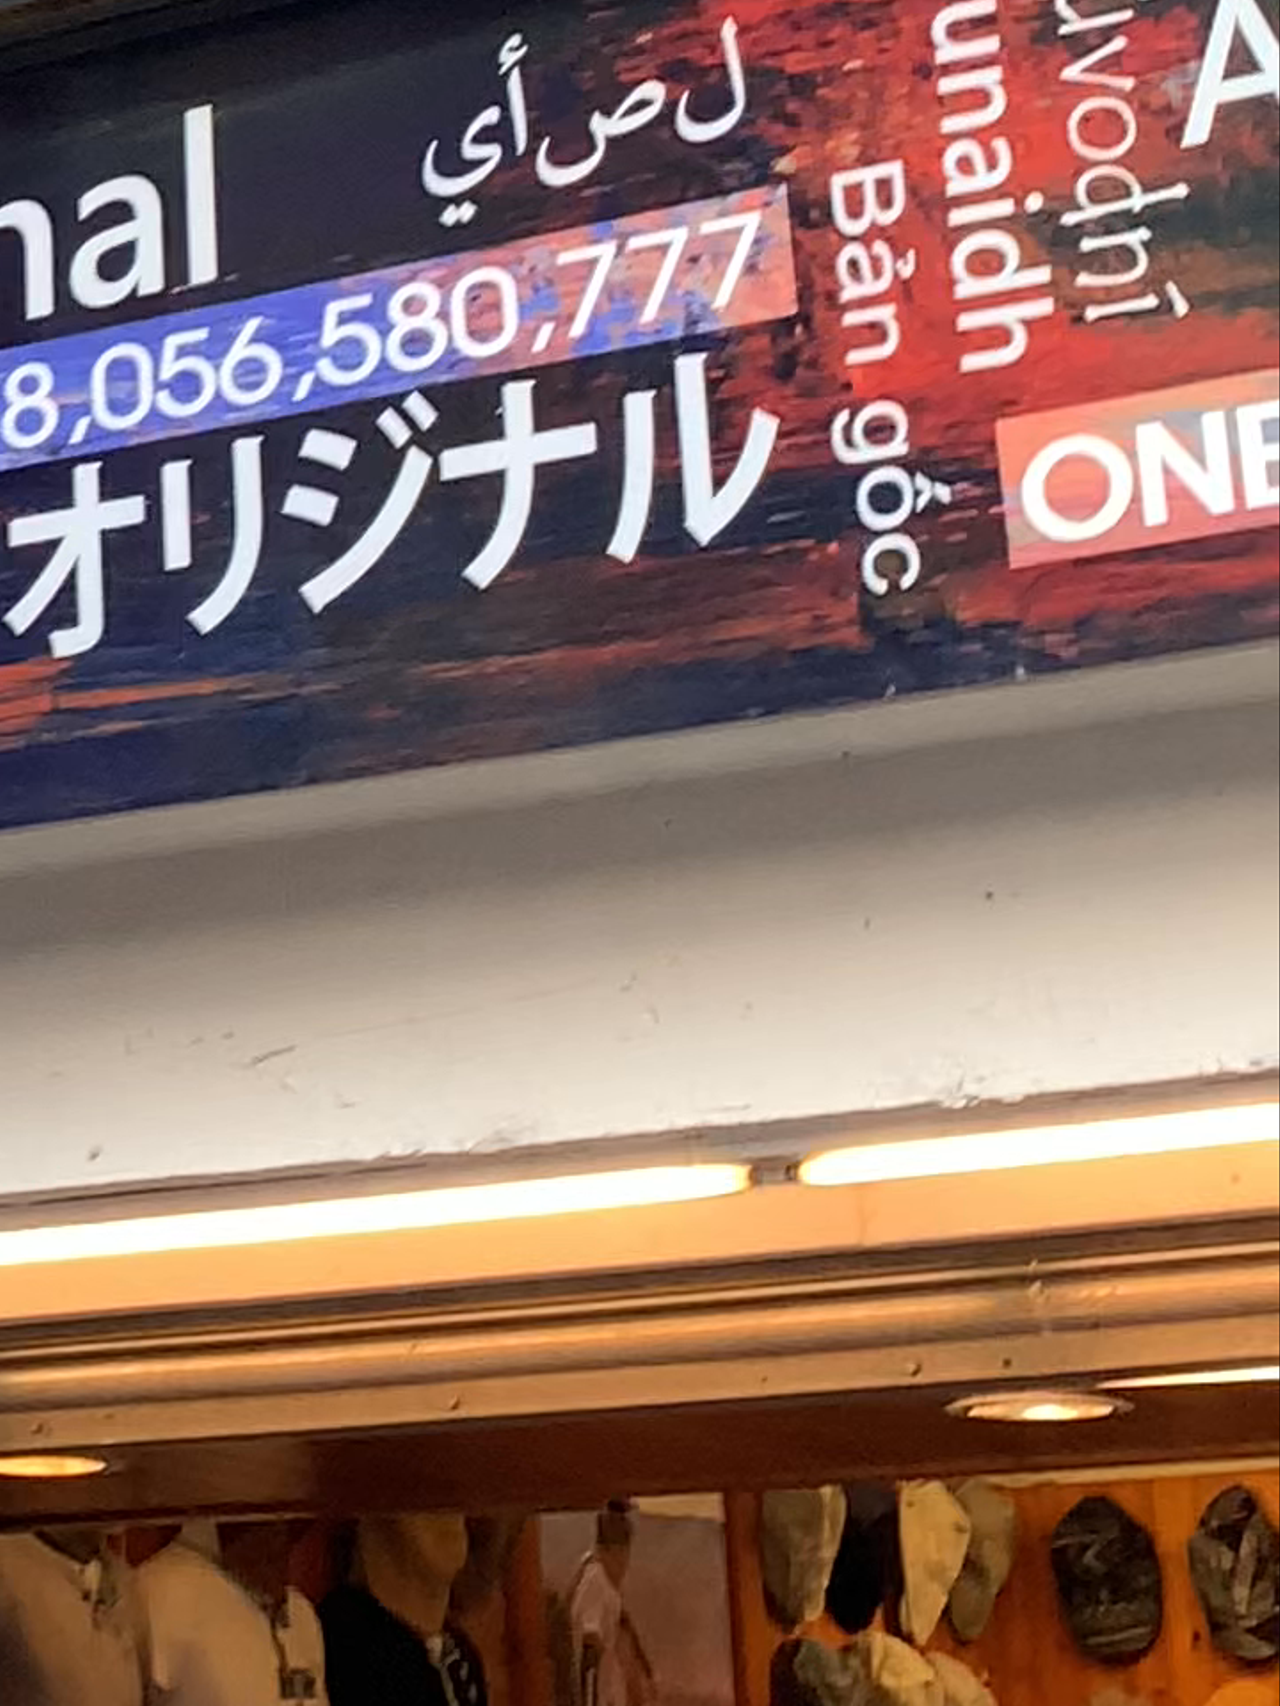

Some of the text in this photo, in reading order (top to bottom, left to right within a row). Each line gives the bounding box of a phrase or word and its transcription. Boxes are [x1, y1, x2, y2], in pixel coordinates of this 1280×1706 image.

[1, 352, 780, 659] オリジナル
[831, 159, 952, 598] Bản gốc
